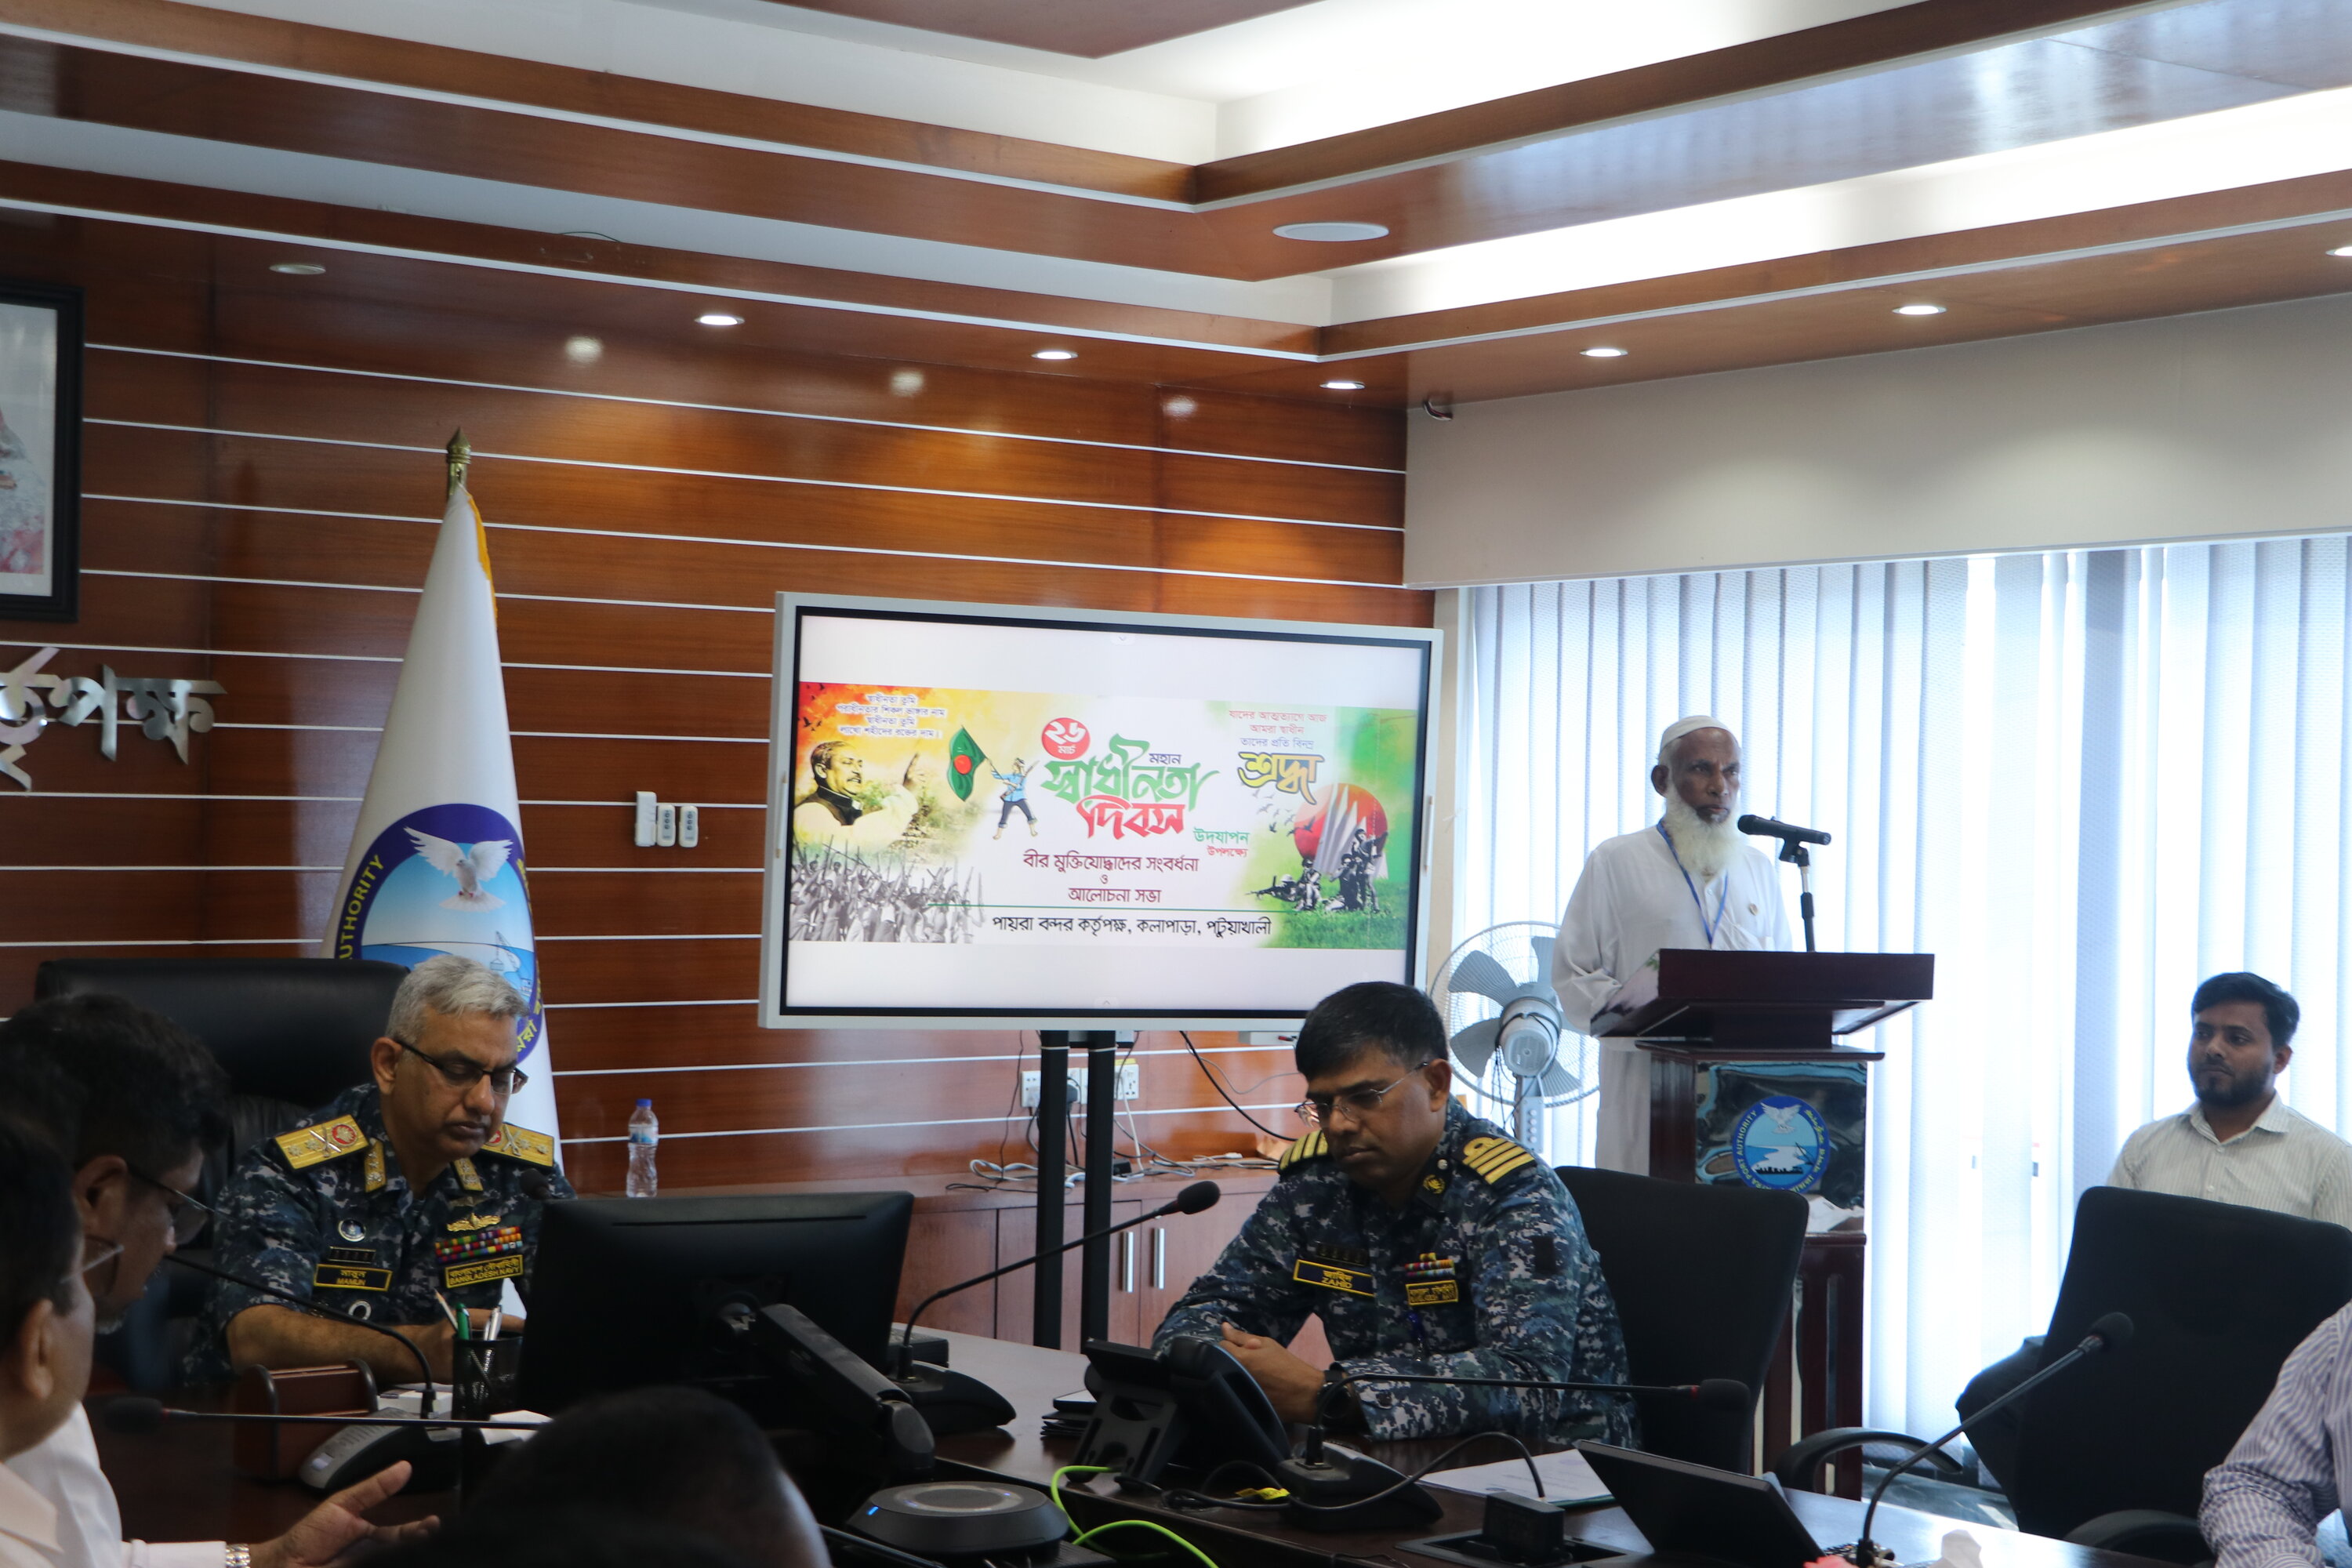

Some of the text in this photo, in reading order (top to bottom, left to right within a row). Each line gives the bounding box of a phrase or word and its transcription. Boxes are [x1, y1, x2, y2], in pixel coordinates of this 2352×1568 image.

[866, 692, 916, 706] স্বাধীনতা তুমি
[0, 646, 227, 791] র্তৃপক্ষ
[931, 708, 946, 717] নাম
[1229, 710, 1255, 720] যাদের
[1308, 713, 1327, 722] আজ
[866, 714, 916, 728] স্বাধীনতা তুমি
[1250, 722, 1305, 734] আমরা স্বাধীন
[1044, 720, 1088, 746] ২৬
[1240, 736, 1314, 750] তাদের প্রতি বিনম্র
[1149, 753, 1182, 765] মহান
[1040, 733, 1221, 812] স্বাধীনতা
[1236, 750, 1326, 806] শ্রদ্ধা
[1076, 794, 1186, 840] দিবস
[1023, 848, 1200, 873] বীর মুক্তিযোদ্ধাদের সংবর্ধনা
[1099, 874, 1109, 885] ও
[1068, 887, 1163, 903] আলোচনা সভা
[338, 854, 384, 959] UTHORITY
[992, 915, 1272, 939] পায়রা বন্দর কর্তৃপক্ষ, কলাপাড়া, পটুয়াখালী
[1736, 1110, 1757, 1156] AUTHORITY
[1321, 1277, 1353, 1289] ZAHID
